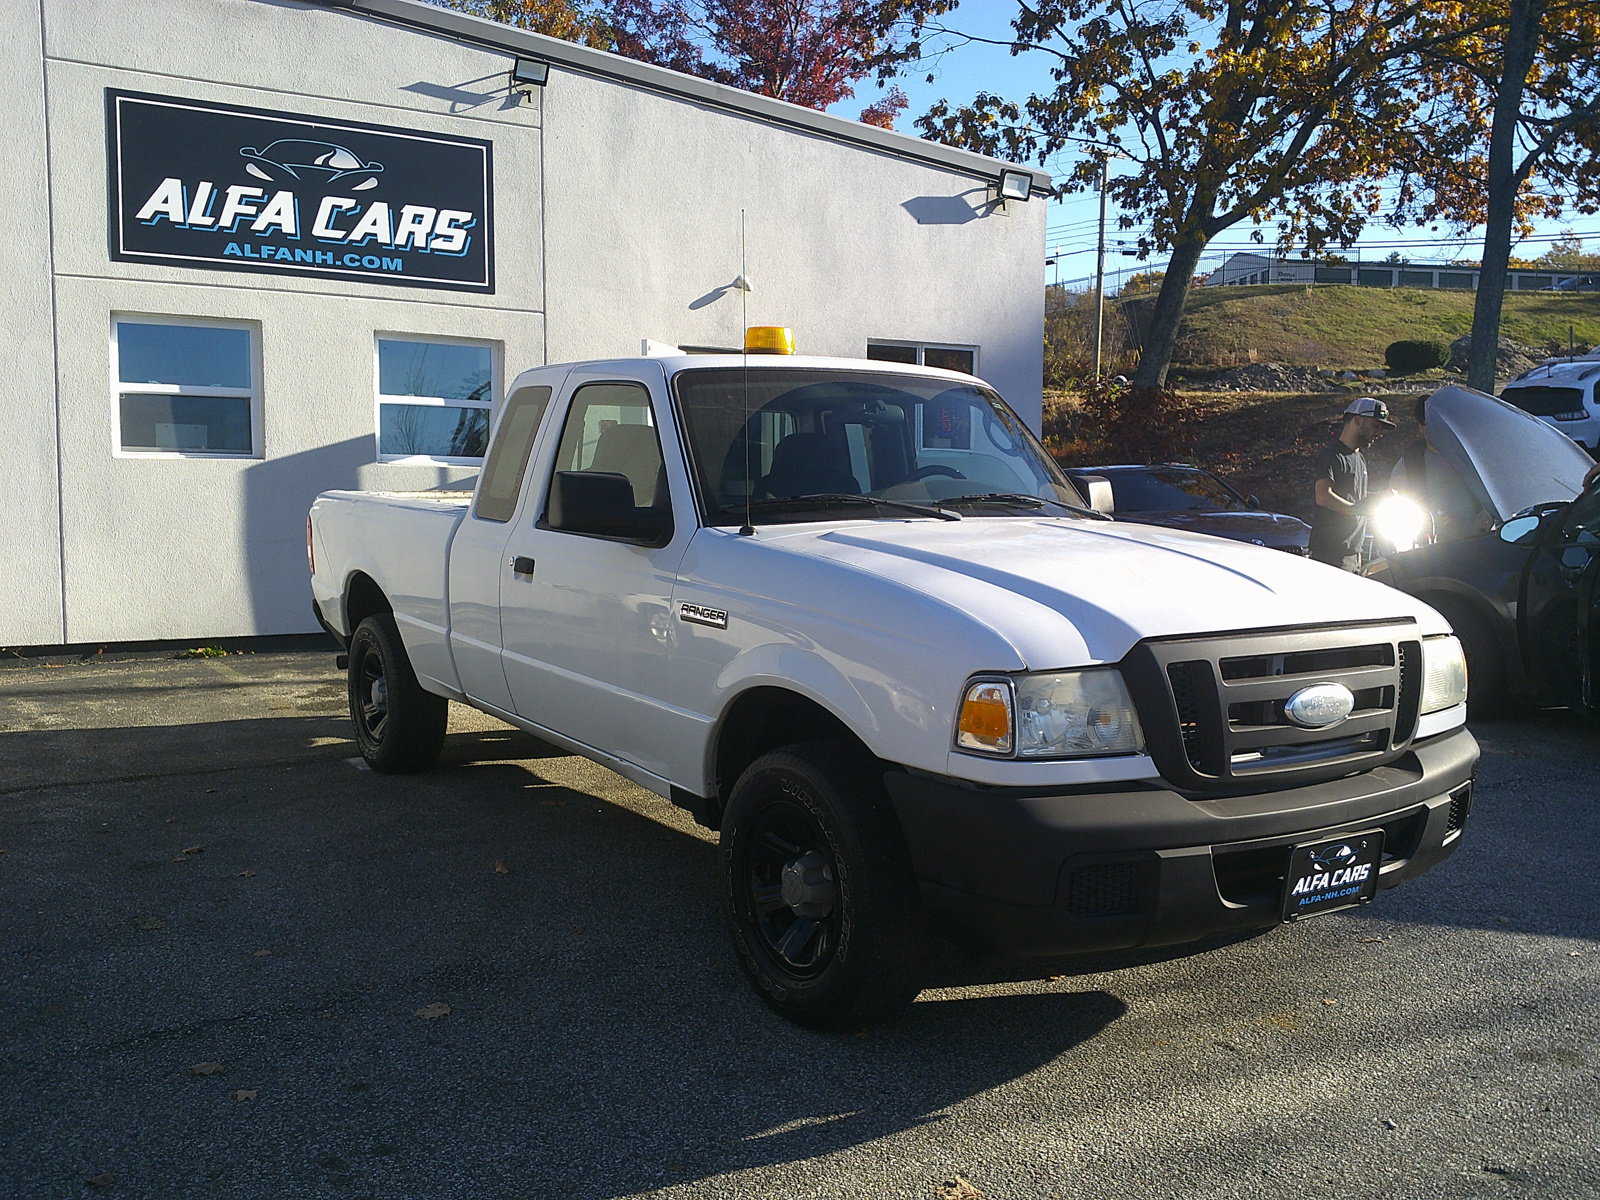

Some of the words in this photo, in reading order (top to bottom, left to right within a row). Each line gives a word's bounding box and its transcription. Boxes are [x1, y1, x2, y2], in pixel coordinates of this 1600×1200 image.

[135, 177, 300, 239] ALFA
[311, 195, 476, 256] CARS
[223, 242, 403, 271] ALFANH.COM
[681, 603, 727, 621] RANGER
[1291, 872, 1330, 896] ALFA
[1331, 863, 1372, 887] CARS
[1299, 886, 1360, 906] ALFA-NH.COM
